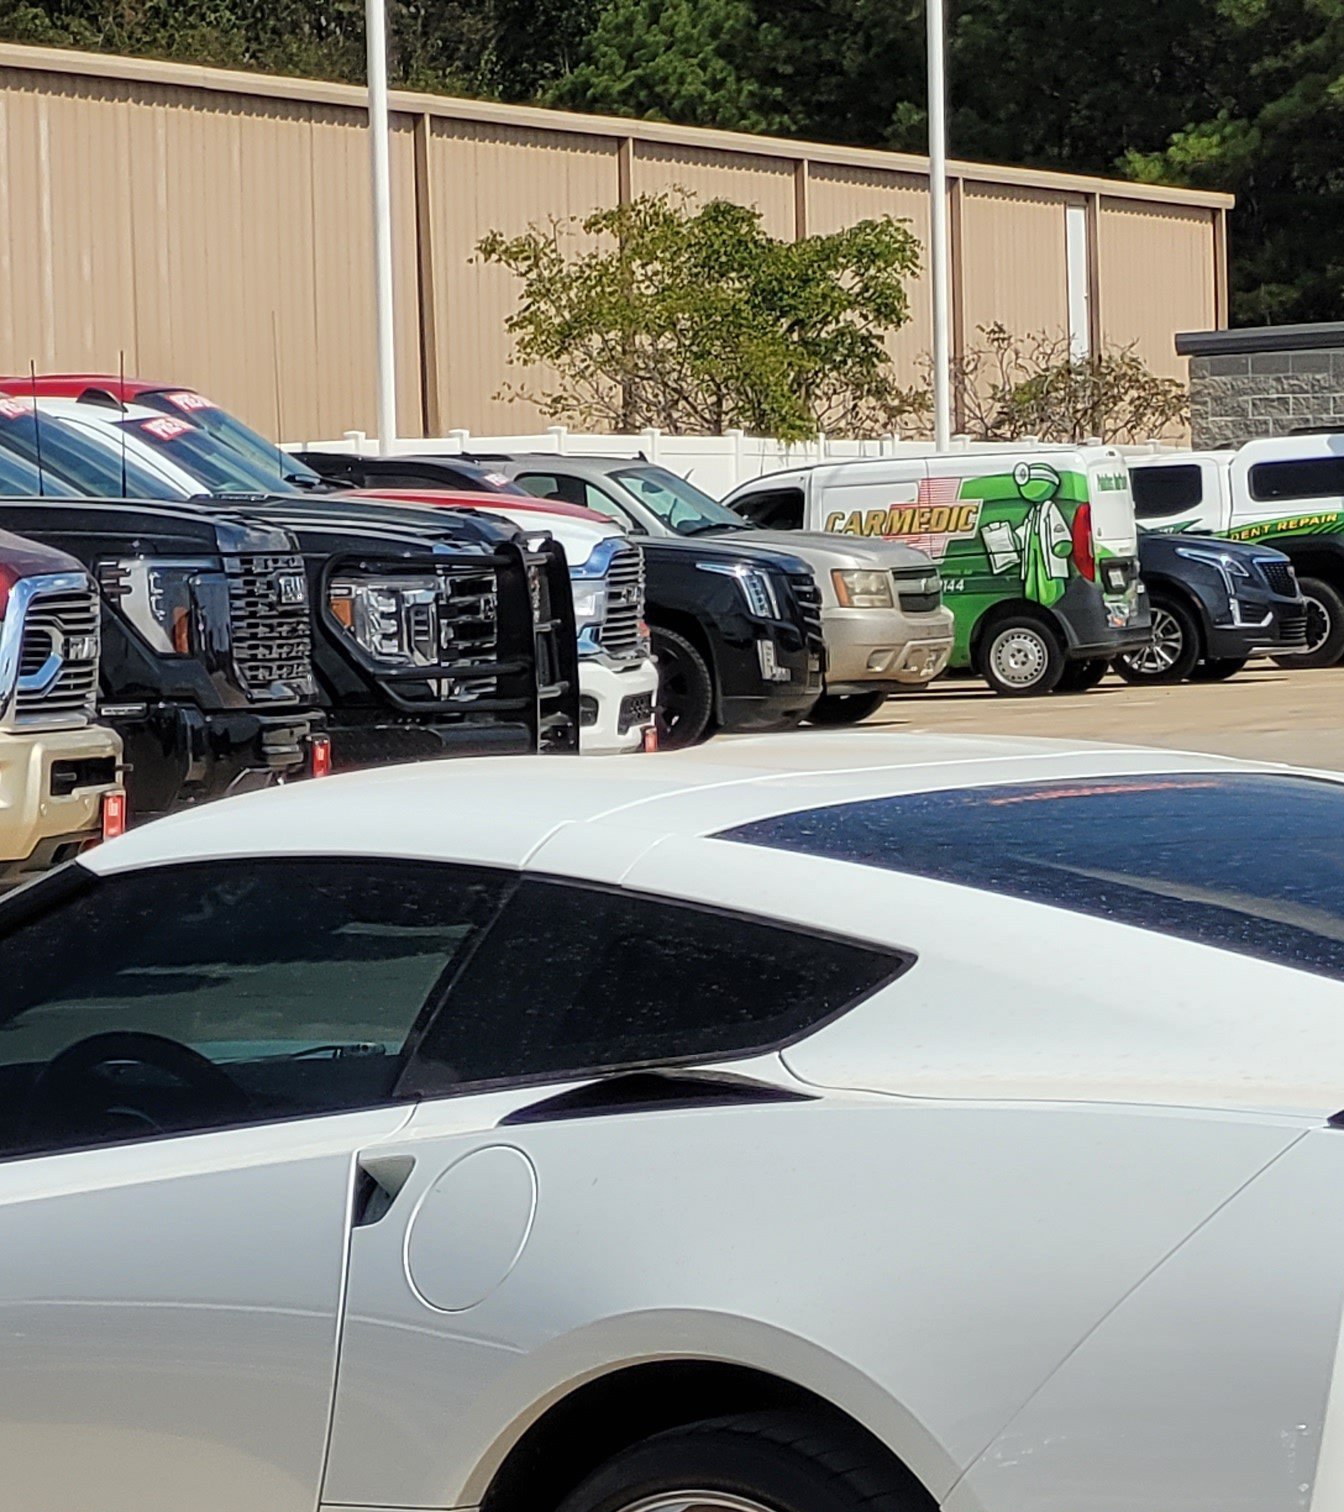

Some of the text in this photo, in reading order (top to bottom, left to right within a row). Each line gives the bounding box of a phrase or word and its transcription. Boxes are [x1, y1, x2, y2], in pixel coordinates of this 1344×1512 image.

[824, 504, 979, 537] CARMEDIC
[1230, 513, 1338, 541] DENT REPAIR
